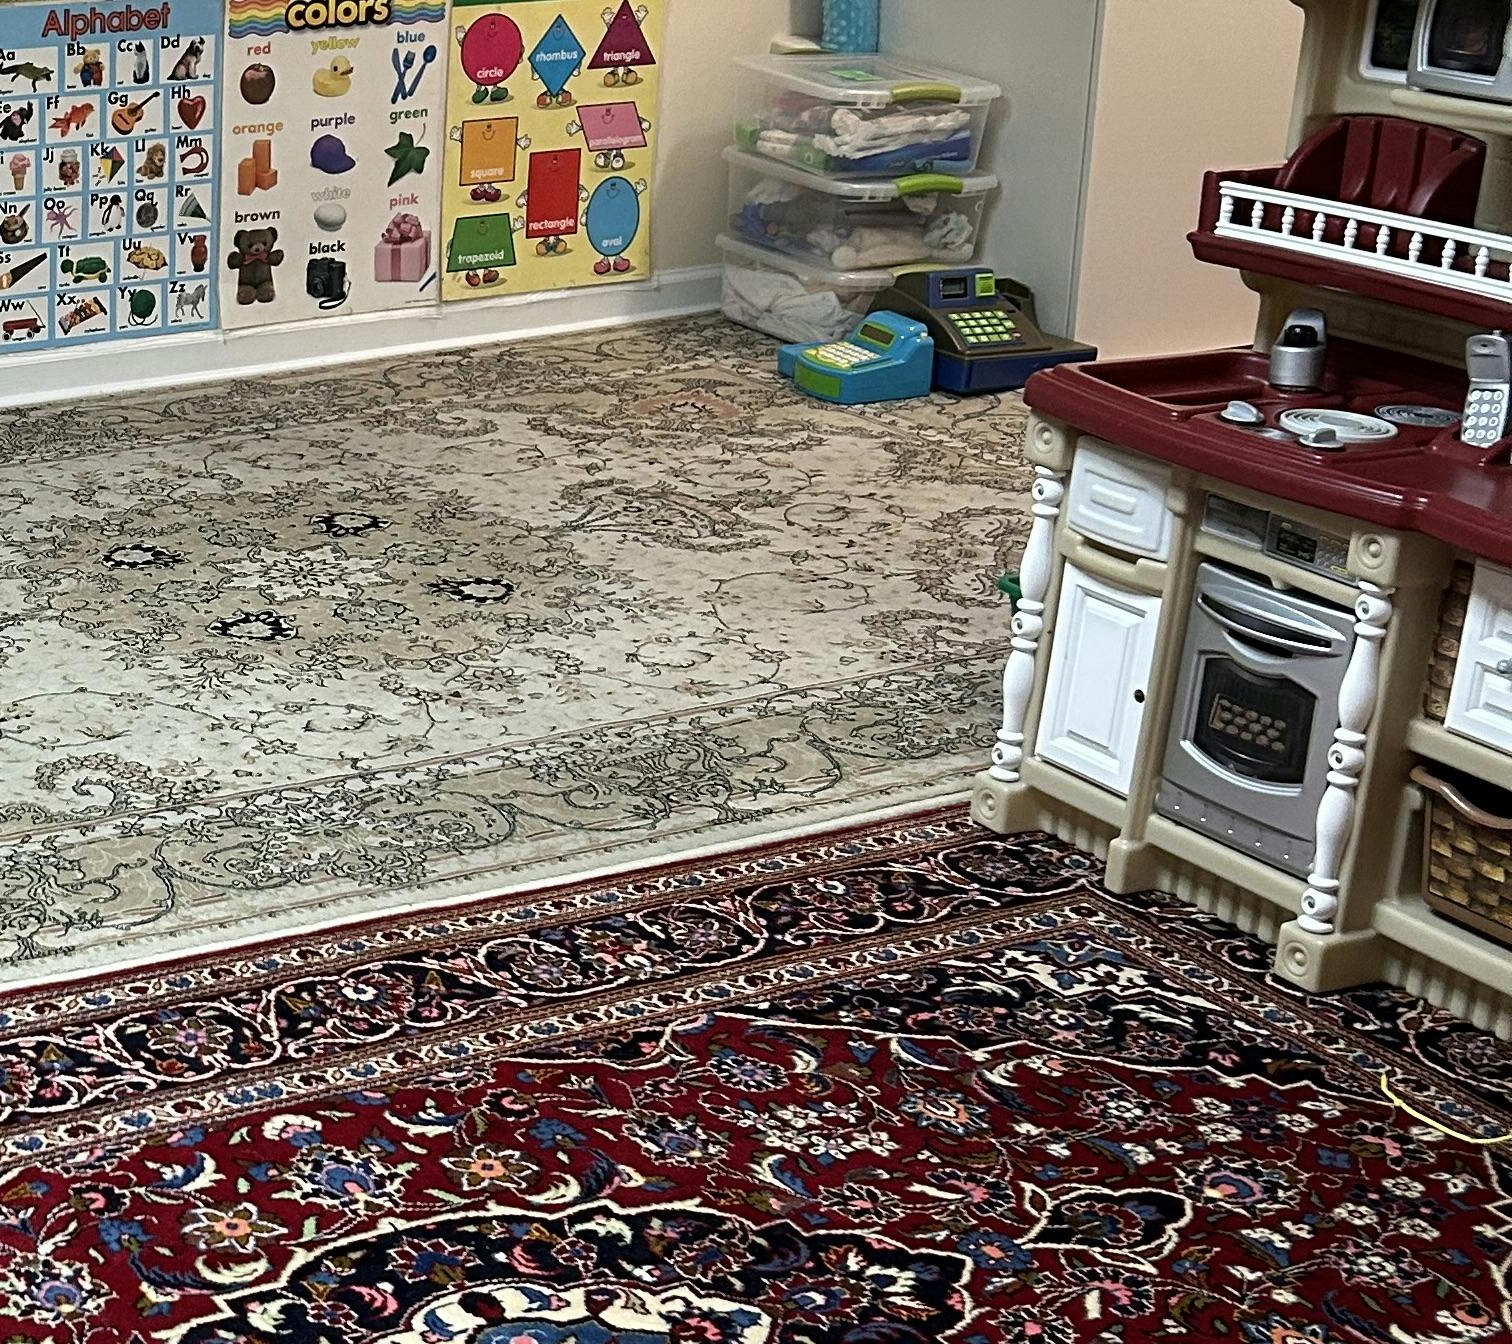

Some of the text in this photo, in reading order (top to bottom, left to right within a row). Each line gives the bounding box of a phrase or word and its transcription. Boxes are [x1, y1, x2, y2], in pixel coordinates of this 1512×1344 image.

[42, 3, 170, 41] Alphabet
[161, 35, 180, 49] Dd
[397, 31, 426, 44] blue
[247, 41, 271, 56] red
[311, 36, 360, 55] yellow
[536, 49, 578, 62] rhombus
[603, 49, 640, 62] triangle
[477, 67, 504, 79] circle
[108, 91, 129, 106] Gg
[311, 113, 356, 131] purple
[389, 108, 428, 124] green
[232, 120, 284, 136] orange
[470, 167, 504, 179] square
[311, 187, 351, 202] white
[389, 193, 419, 209] pink
[235, 210, 280, 223] brown
[529, 217, 575, 230] rectangle
[309, 240, 346, 254] black
[602, 236, 622, 247] oval
[458, 249, 504, 264] trapezoid
